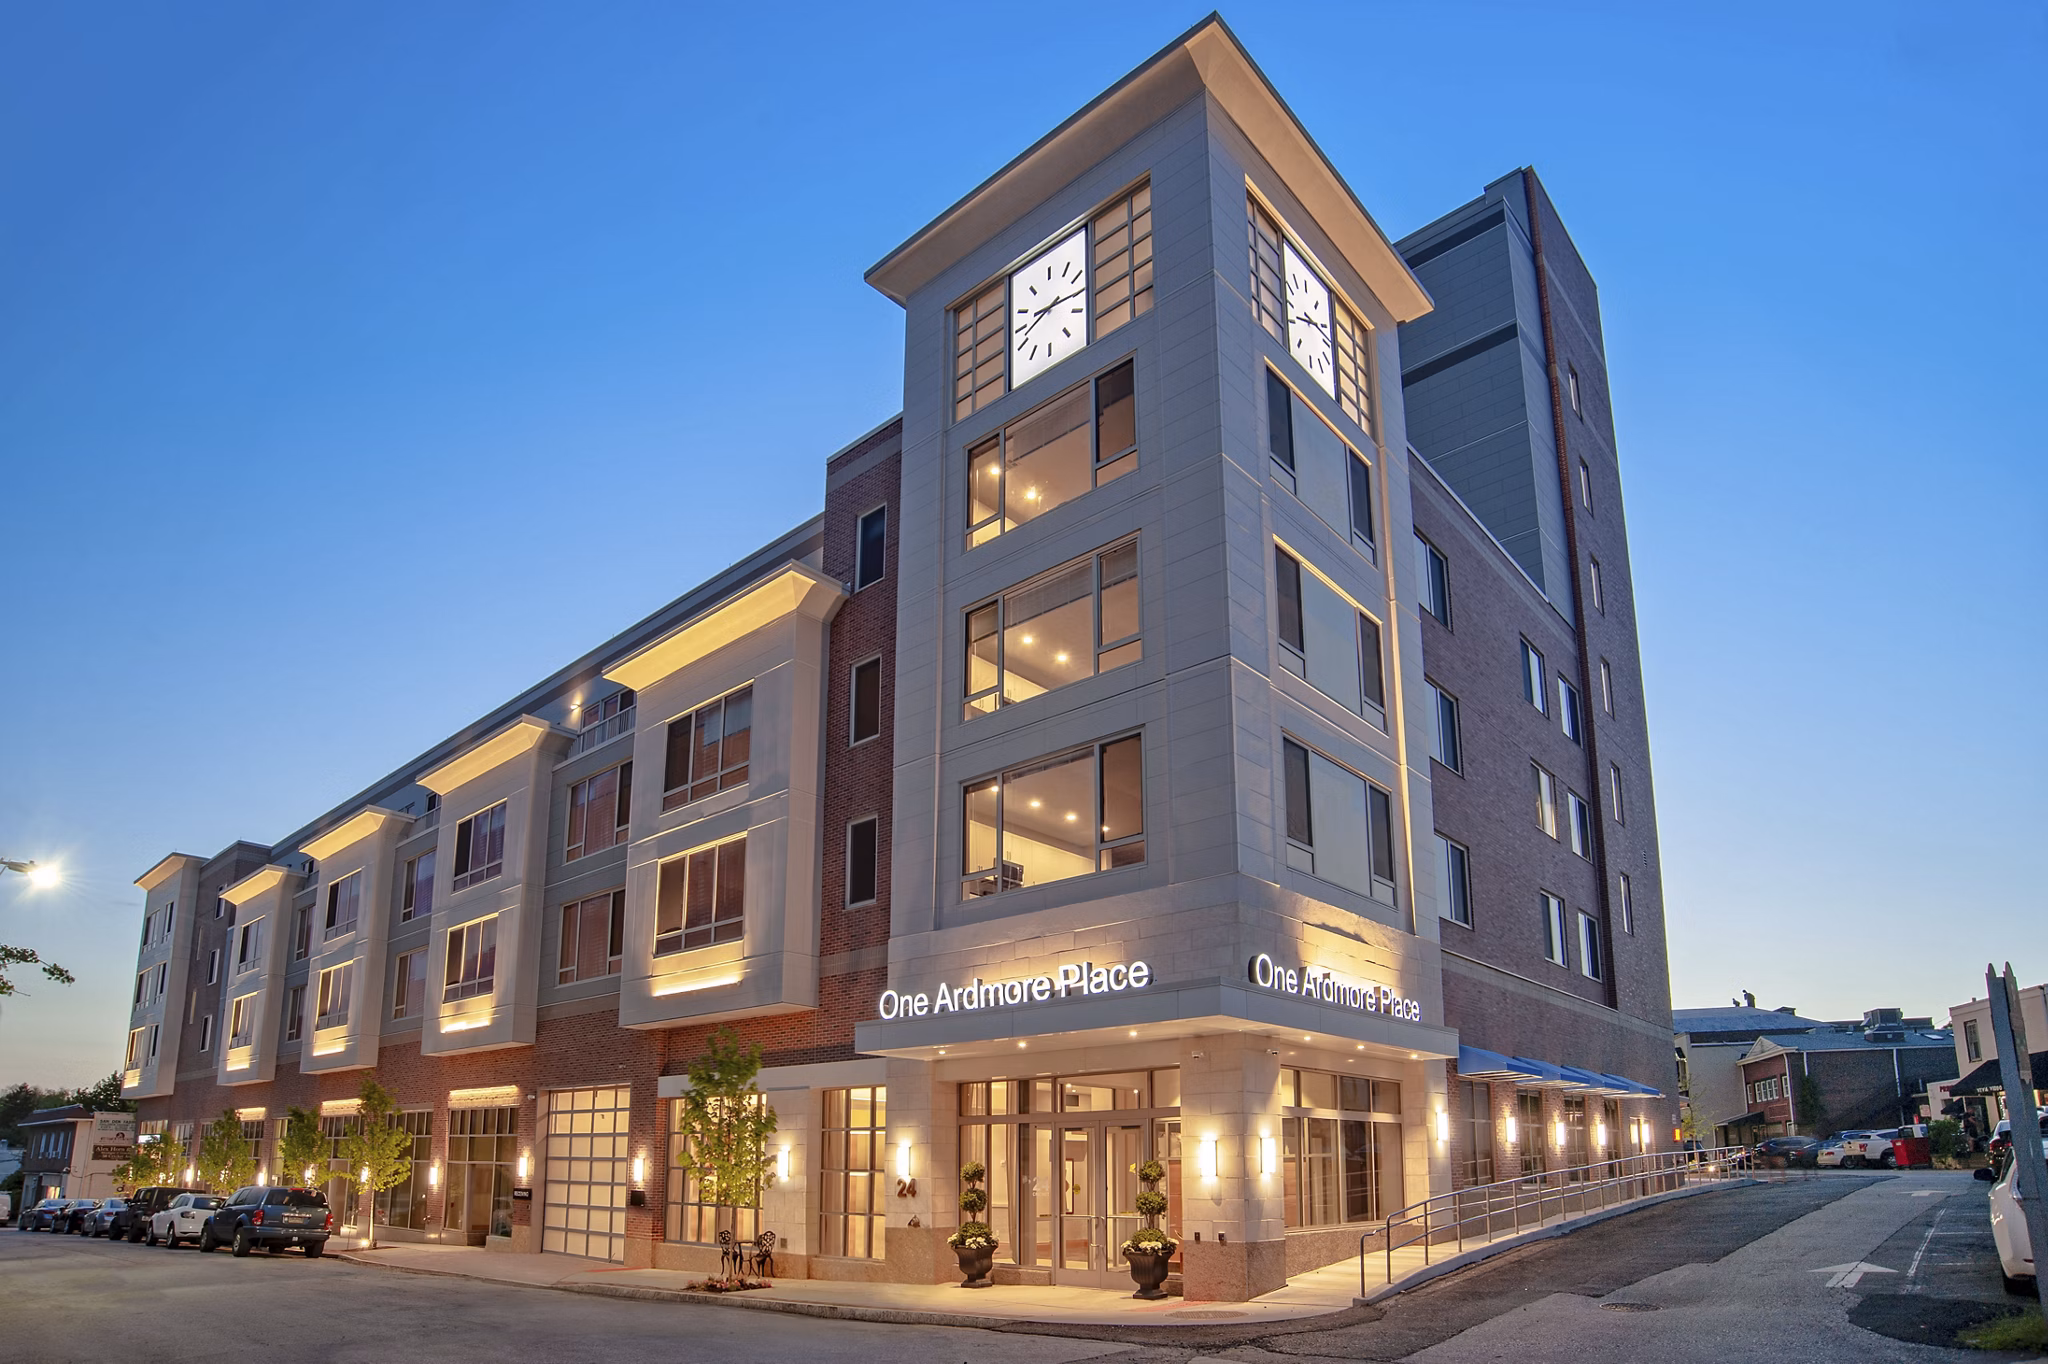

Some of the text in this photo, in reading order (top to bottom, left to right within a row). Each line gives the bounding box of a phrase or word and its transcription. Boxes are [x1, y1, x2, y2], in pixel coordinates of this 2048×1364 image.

[879, 960, 1149, 1020] One Ardmore Place
[1255, 953, 1422, 1022] One Ardmore Place
[897, 1178, 917, 1198] 24
